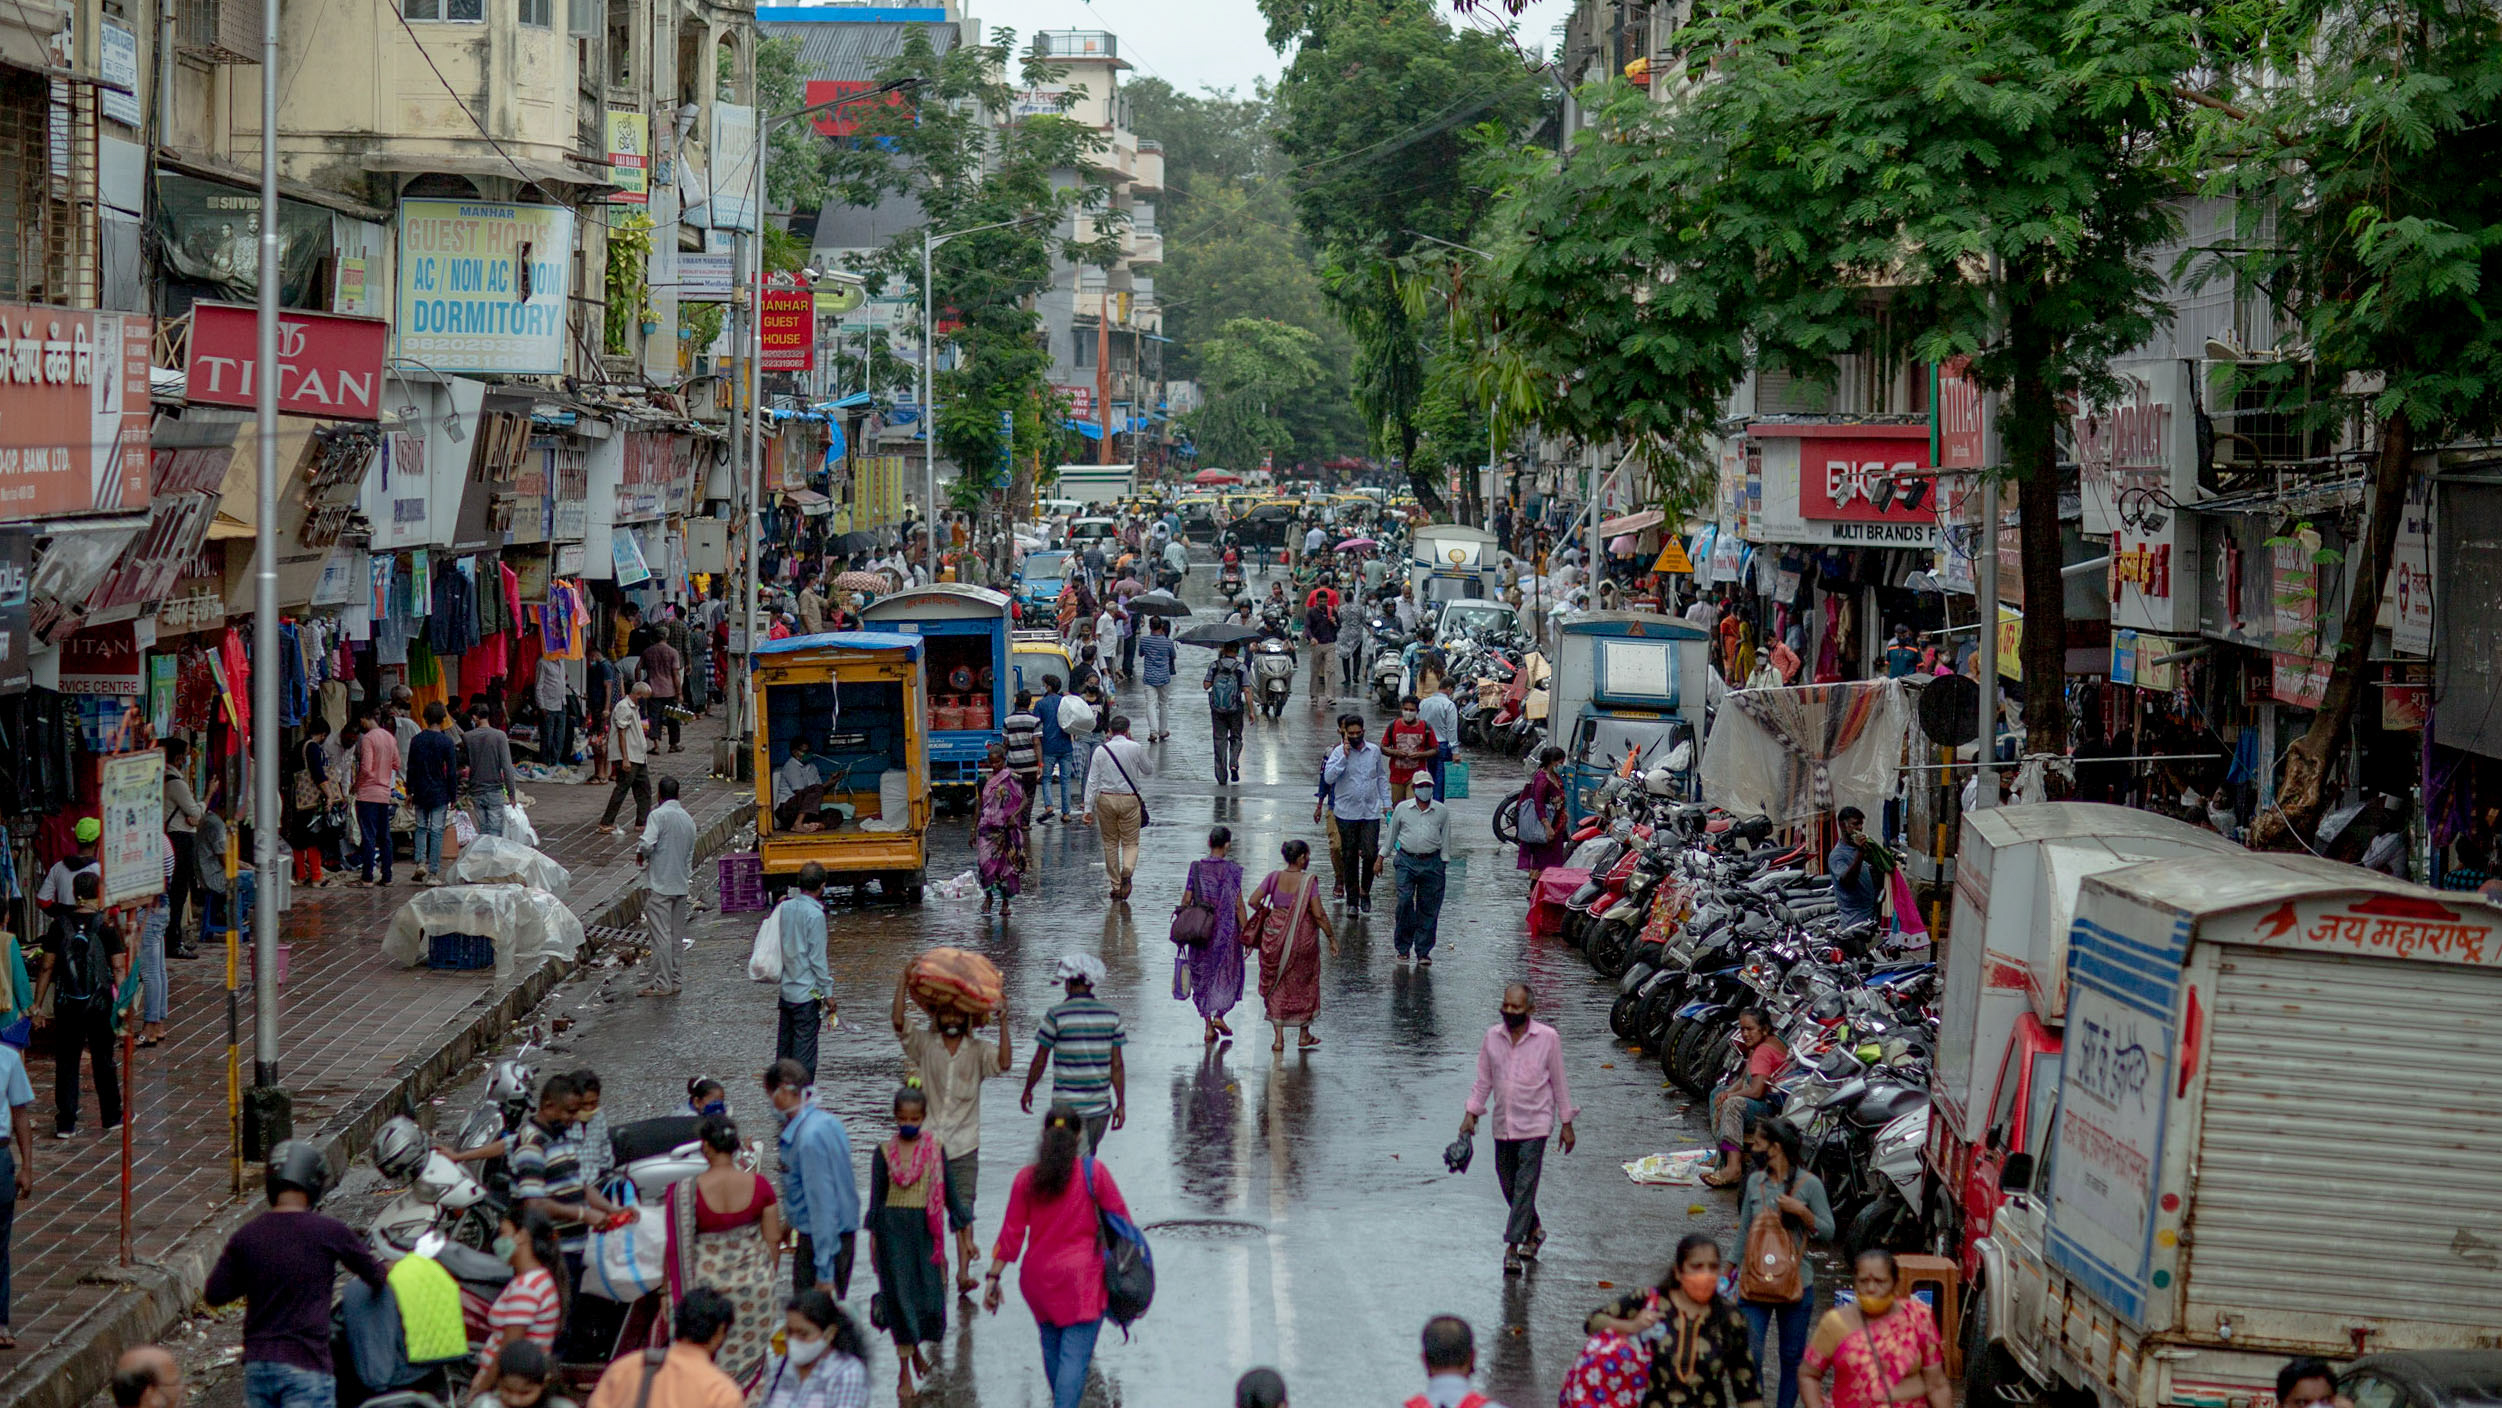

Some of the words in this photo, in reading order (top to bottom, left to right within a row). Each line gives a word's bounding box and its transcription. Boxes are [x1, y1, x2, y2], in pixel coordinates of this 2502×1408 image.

[220, 197, 279, 210] SUVID
[460, 206, 515, 219] MANHAR
[407, 219, 480, 252] GUEST
[487, 221, 550, 255] HOUS
[413, 257, 435, 291] AC
[451, 258, 483, 292] NON
[487, 259, 508, 292] AC
[513, 262, 561, 296] OOM
[413, 299, 558, 337] DORMITORY
[764, 316, 799, 328] GUEST
[763, 333, 801, 345] HOUSE
[196, 355, 374, 407] TITAN
[24, 447, 49, 473] BANK
[52, 447, 72, 472] LTD.
[1833, 524, 1863, 539] MULTI
[1867, 525, 1923, 541] BRANDS
[59, 681, 90, 693] RVICE
[94, 681, 138, 694] CENTRE
[2308, 915, 2370, 948] जय
[2371, 918, 2493, 963] महाराष्ट्र
